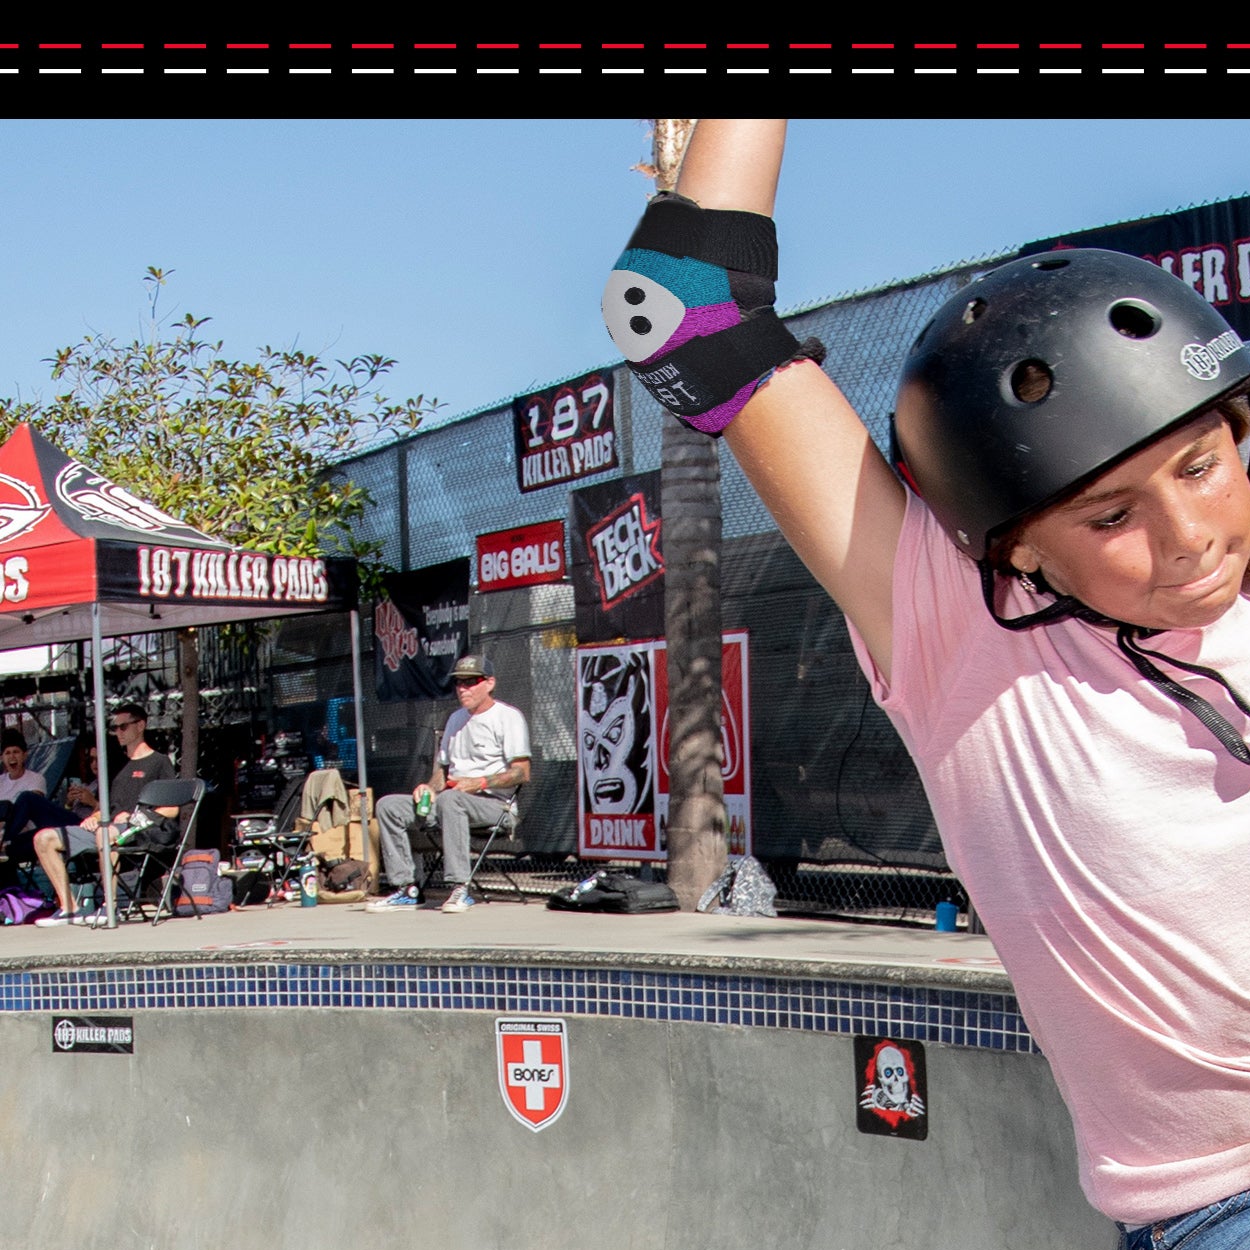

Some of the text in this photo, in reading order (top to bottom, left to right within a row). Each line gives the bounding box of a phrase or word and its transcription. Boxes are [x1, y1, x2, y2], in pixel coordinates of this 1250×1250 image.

[528, 382, 609, 448] 187
[522, 431, 614, 488] KILLER PADS
[592, 504, 642, 563] TECH
[139, 548, 329, 601] 187 KILLER PADS
[481, 541, 561, 582] BIG BALLS
[601, 533, 662, 600] DECK
[590, 818, 647, 847] DRINK
[76, 1027, 107, 1044] KILLER
[107, 1027, 132, 1044] PADS
